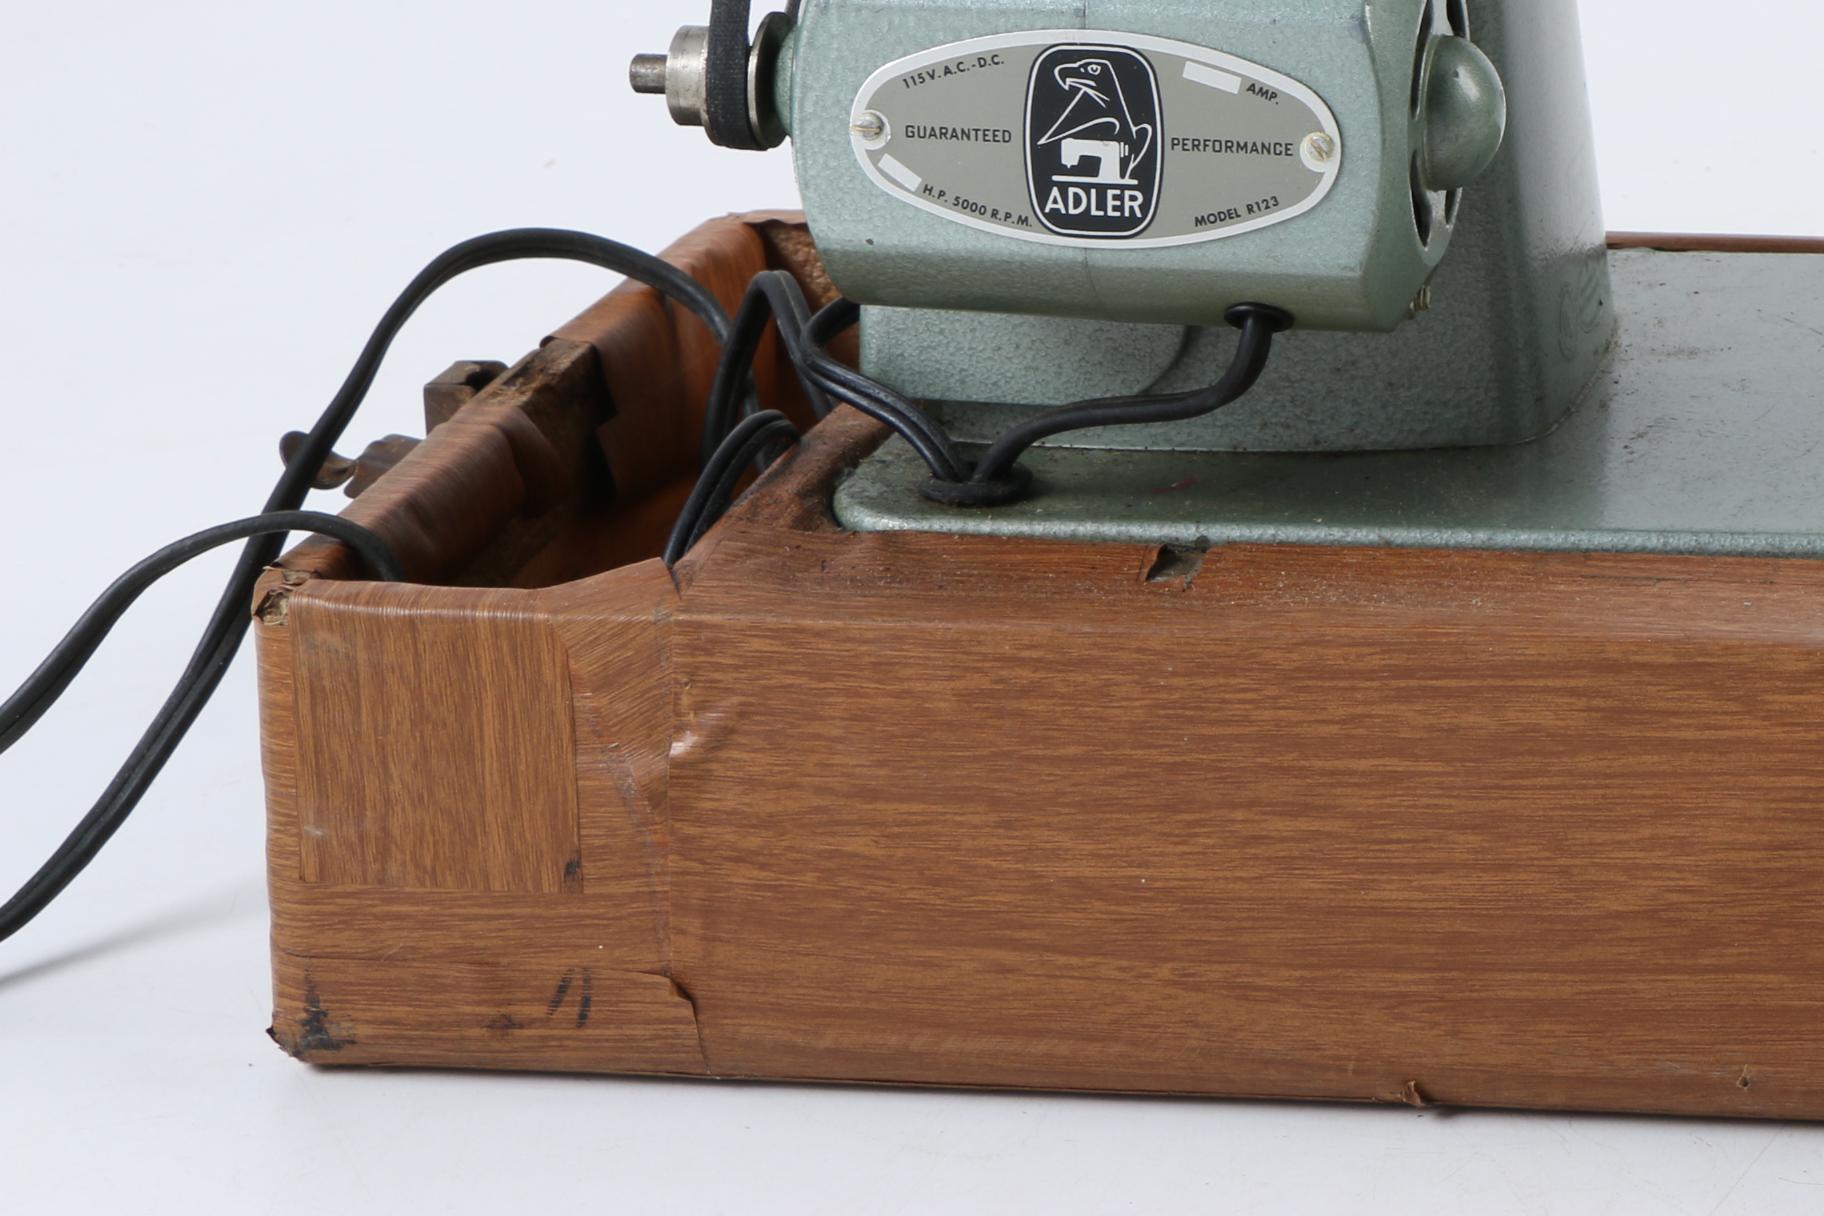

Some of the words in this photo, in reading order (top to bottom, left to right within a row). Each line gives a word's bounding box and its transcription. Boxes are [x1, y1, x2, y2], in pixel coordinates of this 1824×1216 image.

[1246, 83, 1279, 105] AMP.
[905, 125, 1012, 144] GUARANTEED
[1170, 137, 1294, 157] PERFORMANCE
[922, 184, 948, 203] H.P.
[952, 196, 987, 216] 5000
[991, 208, 1033, 227] R.P.M.
[1044, 186, 1144, 218] ADLER
[1194, 207, 1242, 227] MODEL
[1246, 195, 1279, 215] R123
